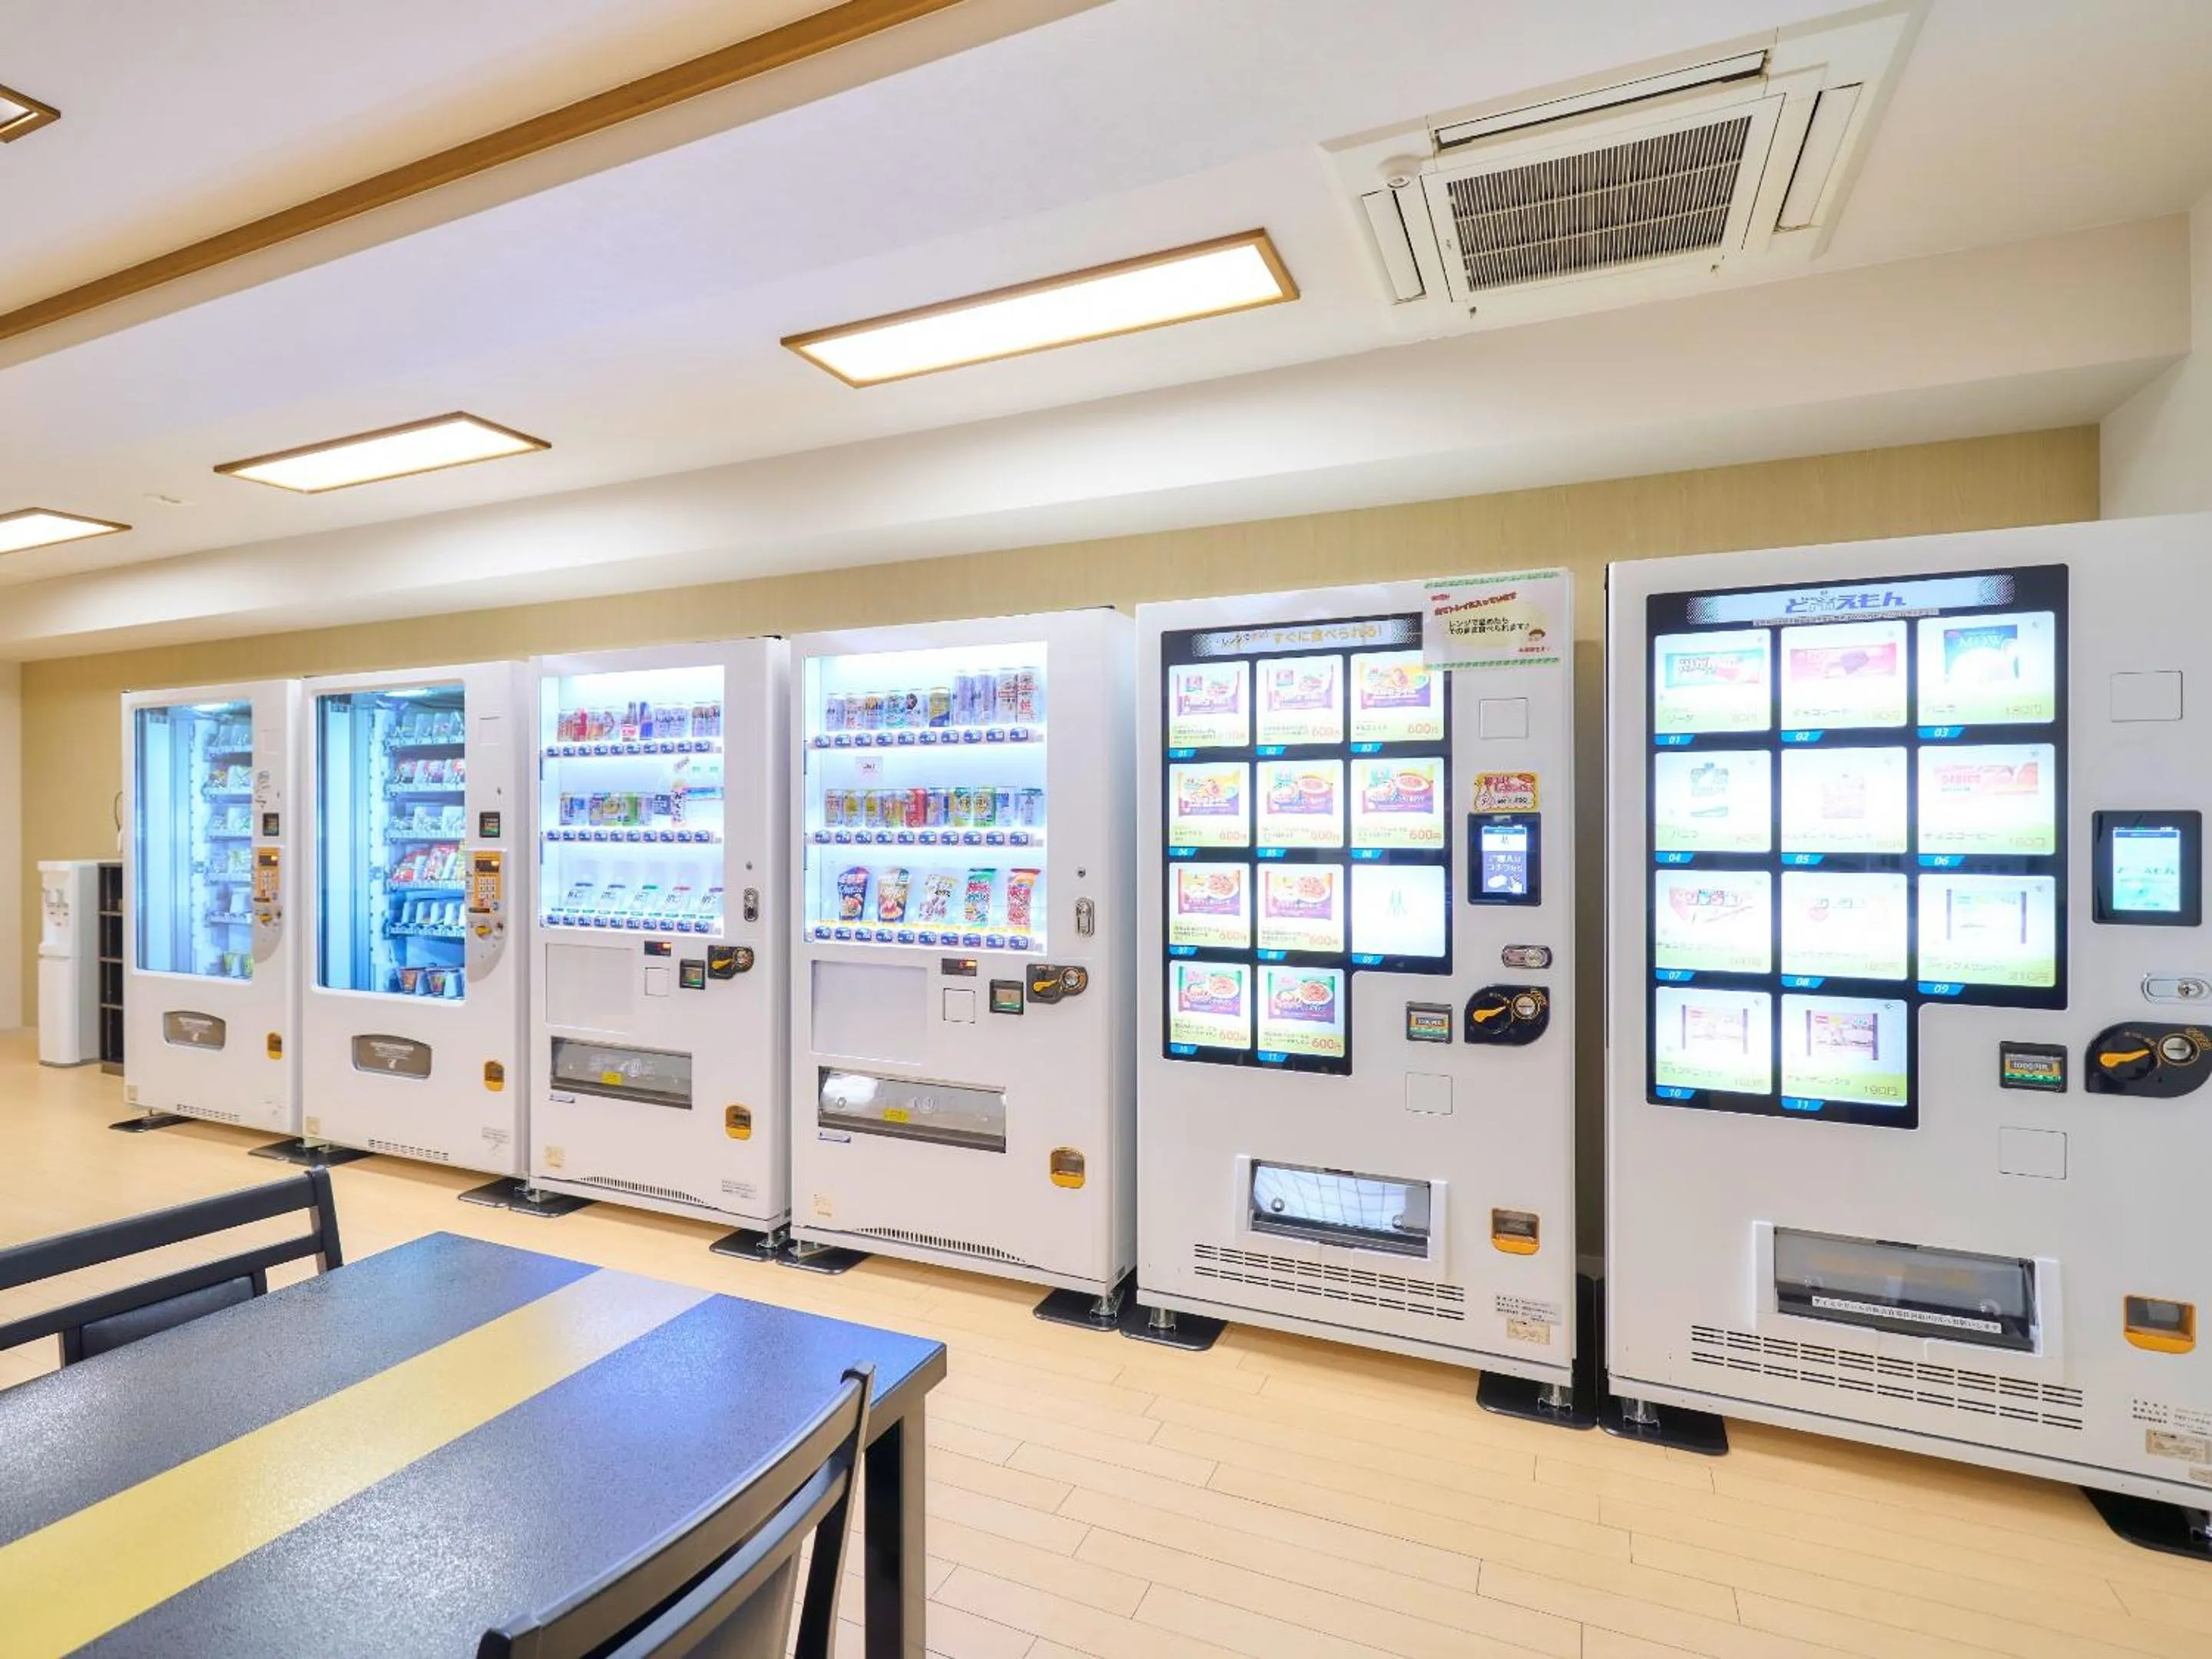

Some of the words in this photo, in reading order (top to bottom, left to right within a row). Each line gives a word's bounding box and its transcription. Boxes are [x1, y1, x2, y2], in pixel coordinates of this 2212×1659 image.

[1795, 732, 1810, 741] 02
[1935, 727, 1949, 737] 03
[1669, 735, 1680, 744] 01
[1669, 854, 1681, 863] 04
[1795, 854, 1810, 864] 05
[1935, 856, 1949, 866] 06
[1669, 972, 1681, 980] 07
[1796, 977, 1810, 987] 08
[1934, 984, 1949, 994] 09
[1310, 1038, 1343, 1051] 600円
[1670, 1088, 1682, 1098] 10
